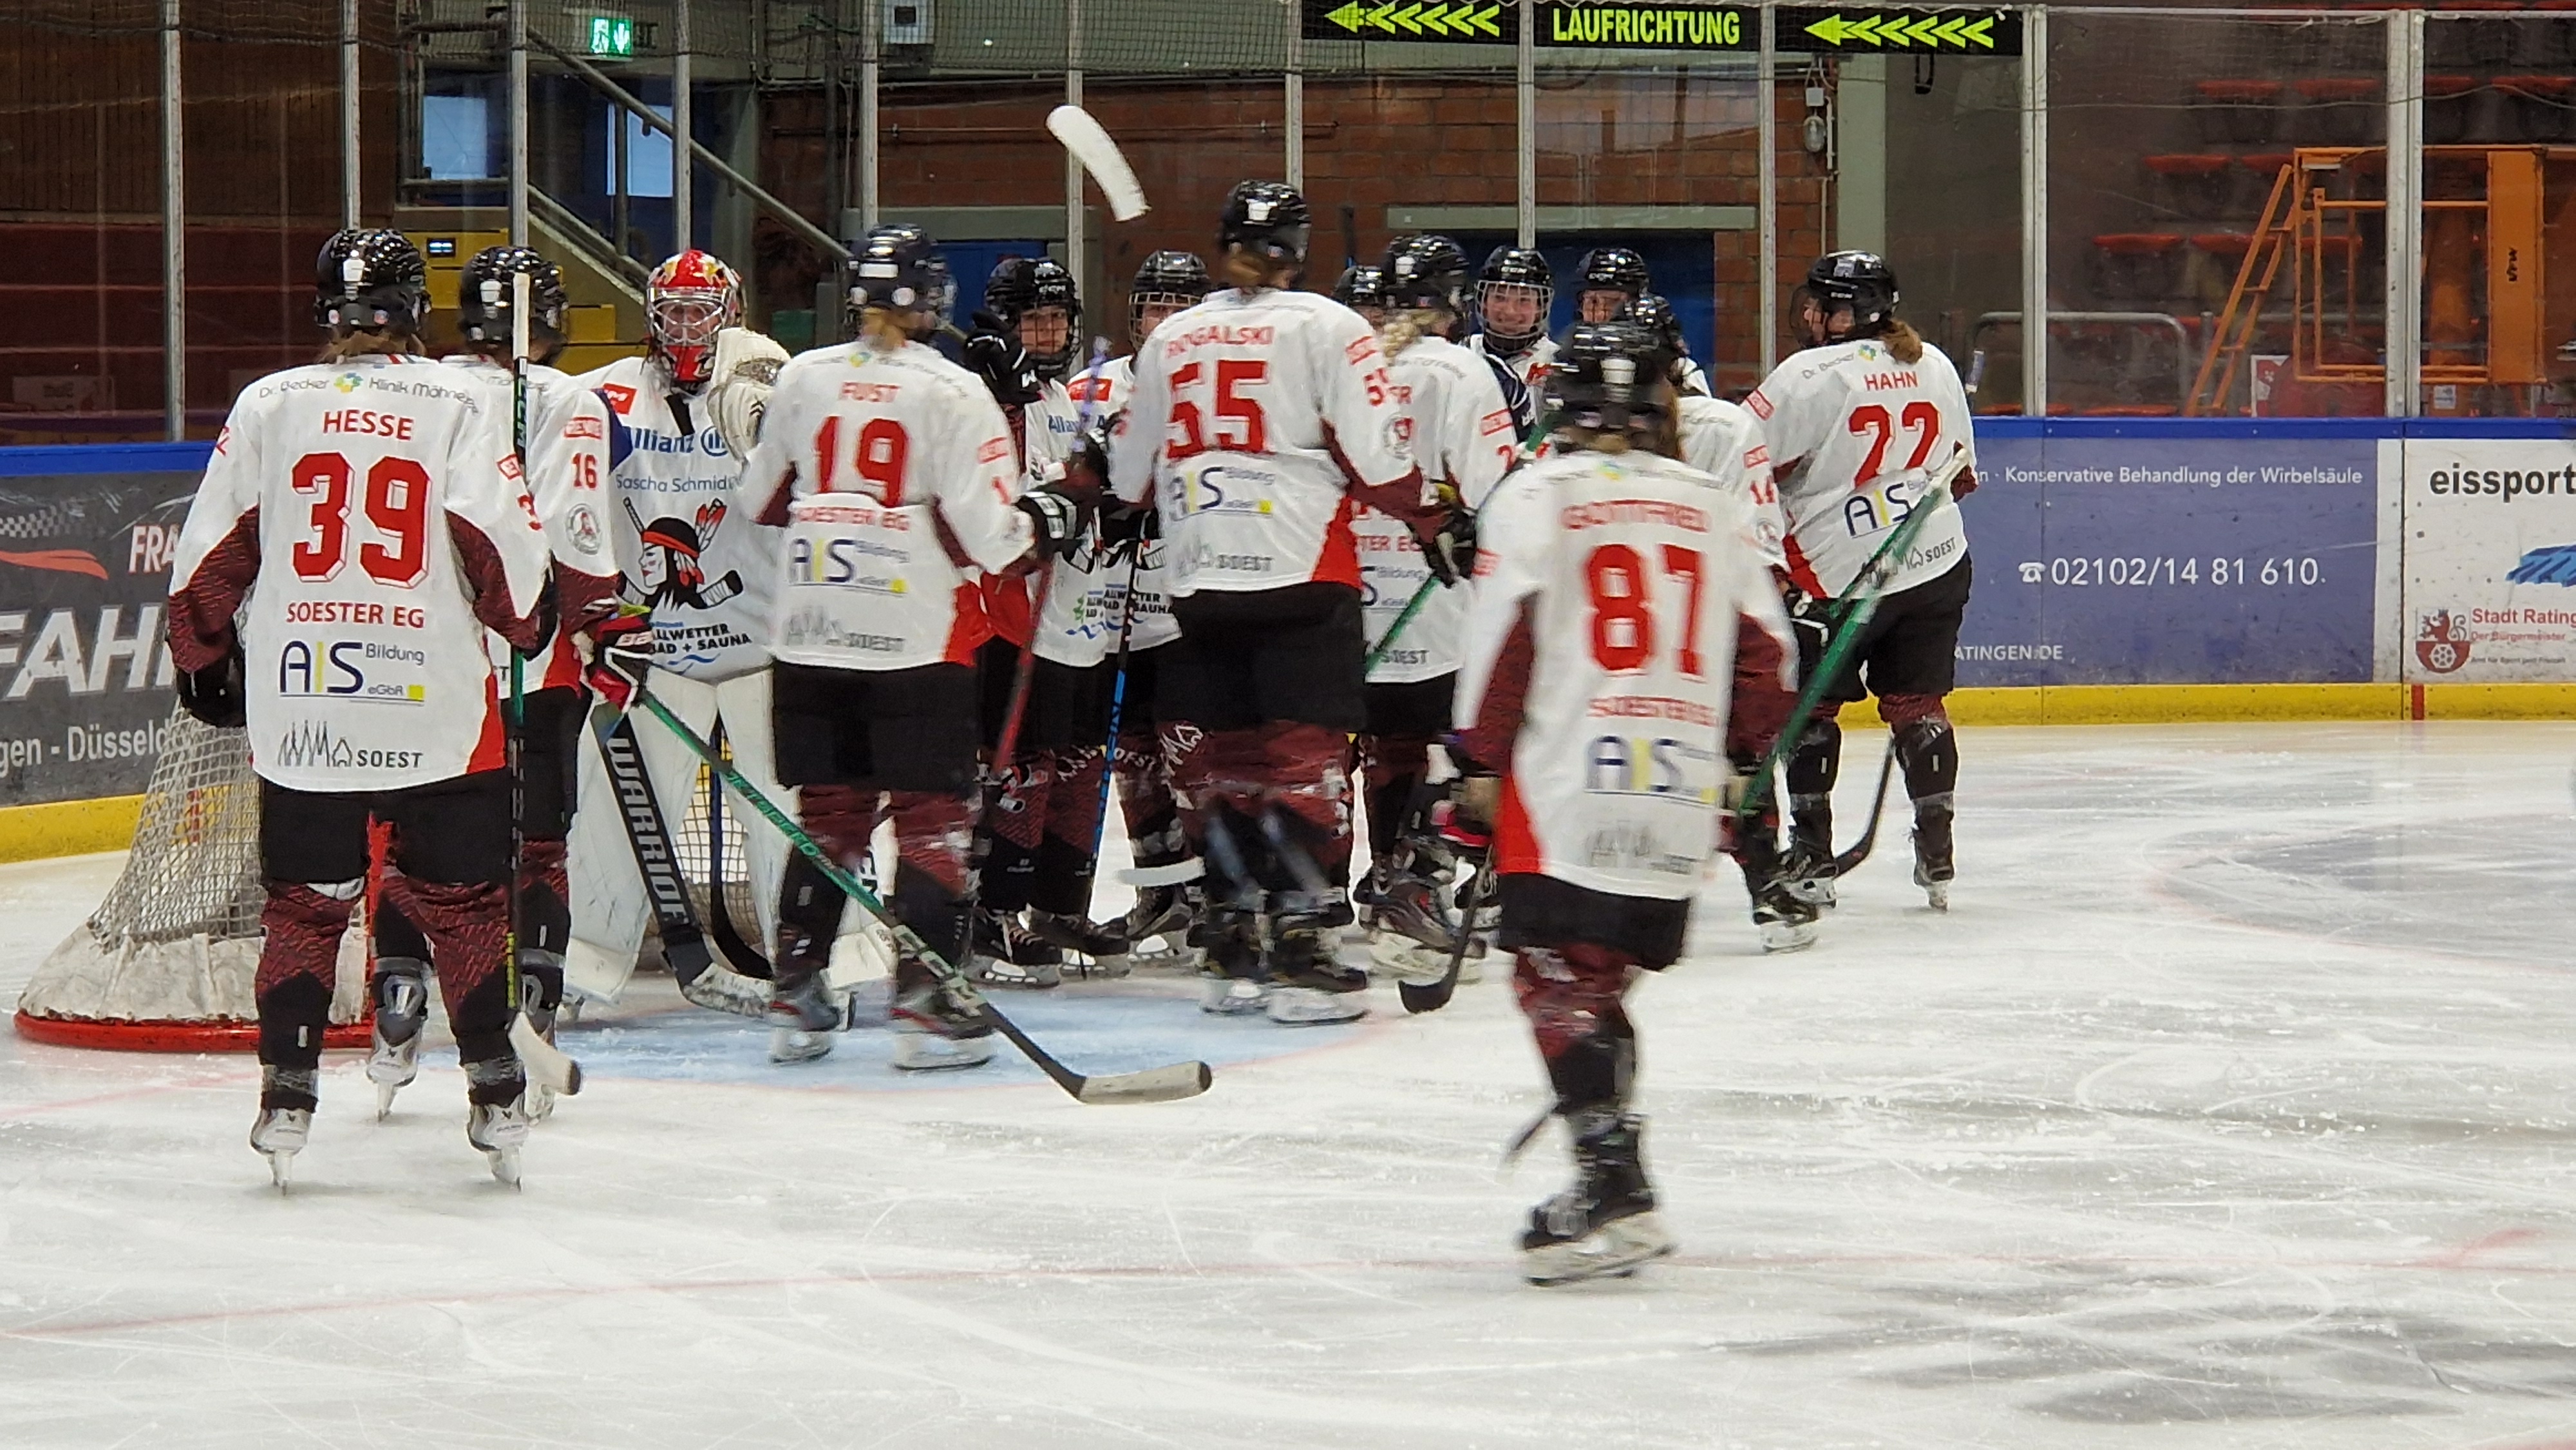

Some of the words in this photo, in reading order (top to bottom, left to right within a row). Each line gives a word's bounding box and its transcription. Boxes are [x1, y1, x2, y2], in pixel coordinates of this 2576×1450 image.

[1553, 8, 1740, 44] LAUFRICHTUNG
[1863, 371, 1919, 391] HAHN
[1166, 359, 1273, 460] 55
[323, 410, 413, 440] HESSE
[633, 427, 694, 453] llianz
[1848, 401, 1942, 489] 22
[572, 452, 598, 490] 16
[813, 415, 911, 507] 19
[616, 475, 668, 493] Sascha
[2005, 466, 2114, 483] Konservative
[2119, 466, 2221, 487] Behandlung
[2226, 467, 2255, 483] der
[2260, 467, 2363, 484] Wirbelsäule
[292, 451, 433, 589] 39
[1925, 537, 1956, 563] SOEST
[2052, 556, 2199, 585] 02102/14
[2211, 558, 2245, 585] 81
[2260, 558, 2326, 585] 610.
[286, 602, 384, 625] SOESTER
[393, 606, 424, 628] EG
[1584, 542, 1708, 677] 87
[2472, 608, 2518, 624] Stadt
[656, 623, 730, 641] LLWETTER
[697, 633, 752, 650] SAUNA
[279, 641, 364, 694] AIS
[365, 643, 425, 666] Bildung
[356, 749, 424, 769] SOEST
